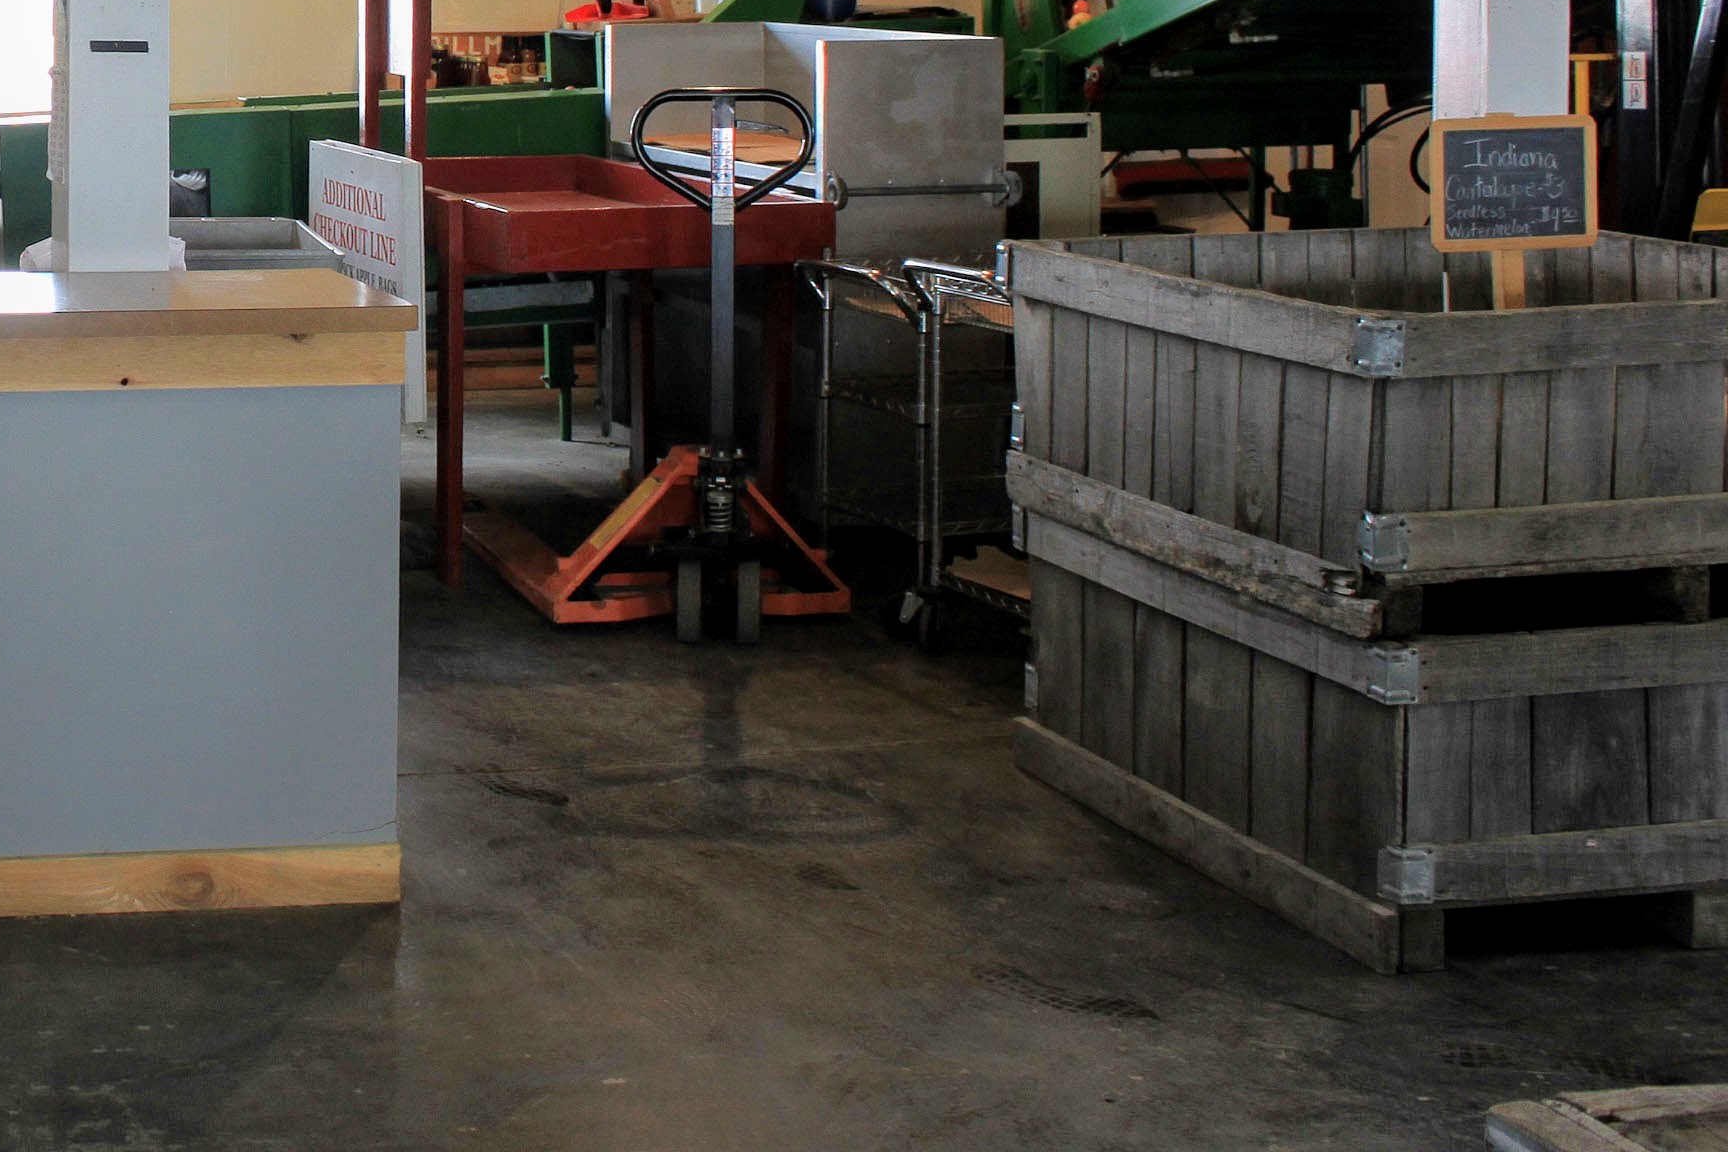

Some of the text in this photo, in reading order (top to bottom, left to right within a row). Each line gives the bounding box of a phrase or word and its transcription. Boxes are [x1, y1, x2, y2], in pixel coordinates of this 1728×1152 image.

[1463, 138, 1559, 169] Indiana
[322, 177, 387, 222] ADDITIONAL
[1446, 204, 1506, 220] Seedless
[313, 212, 397, 266] CHECKOUT LINE
